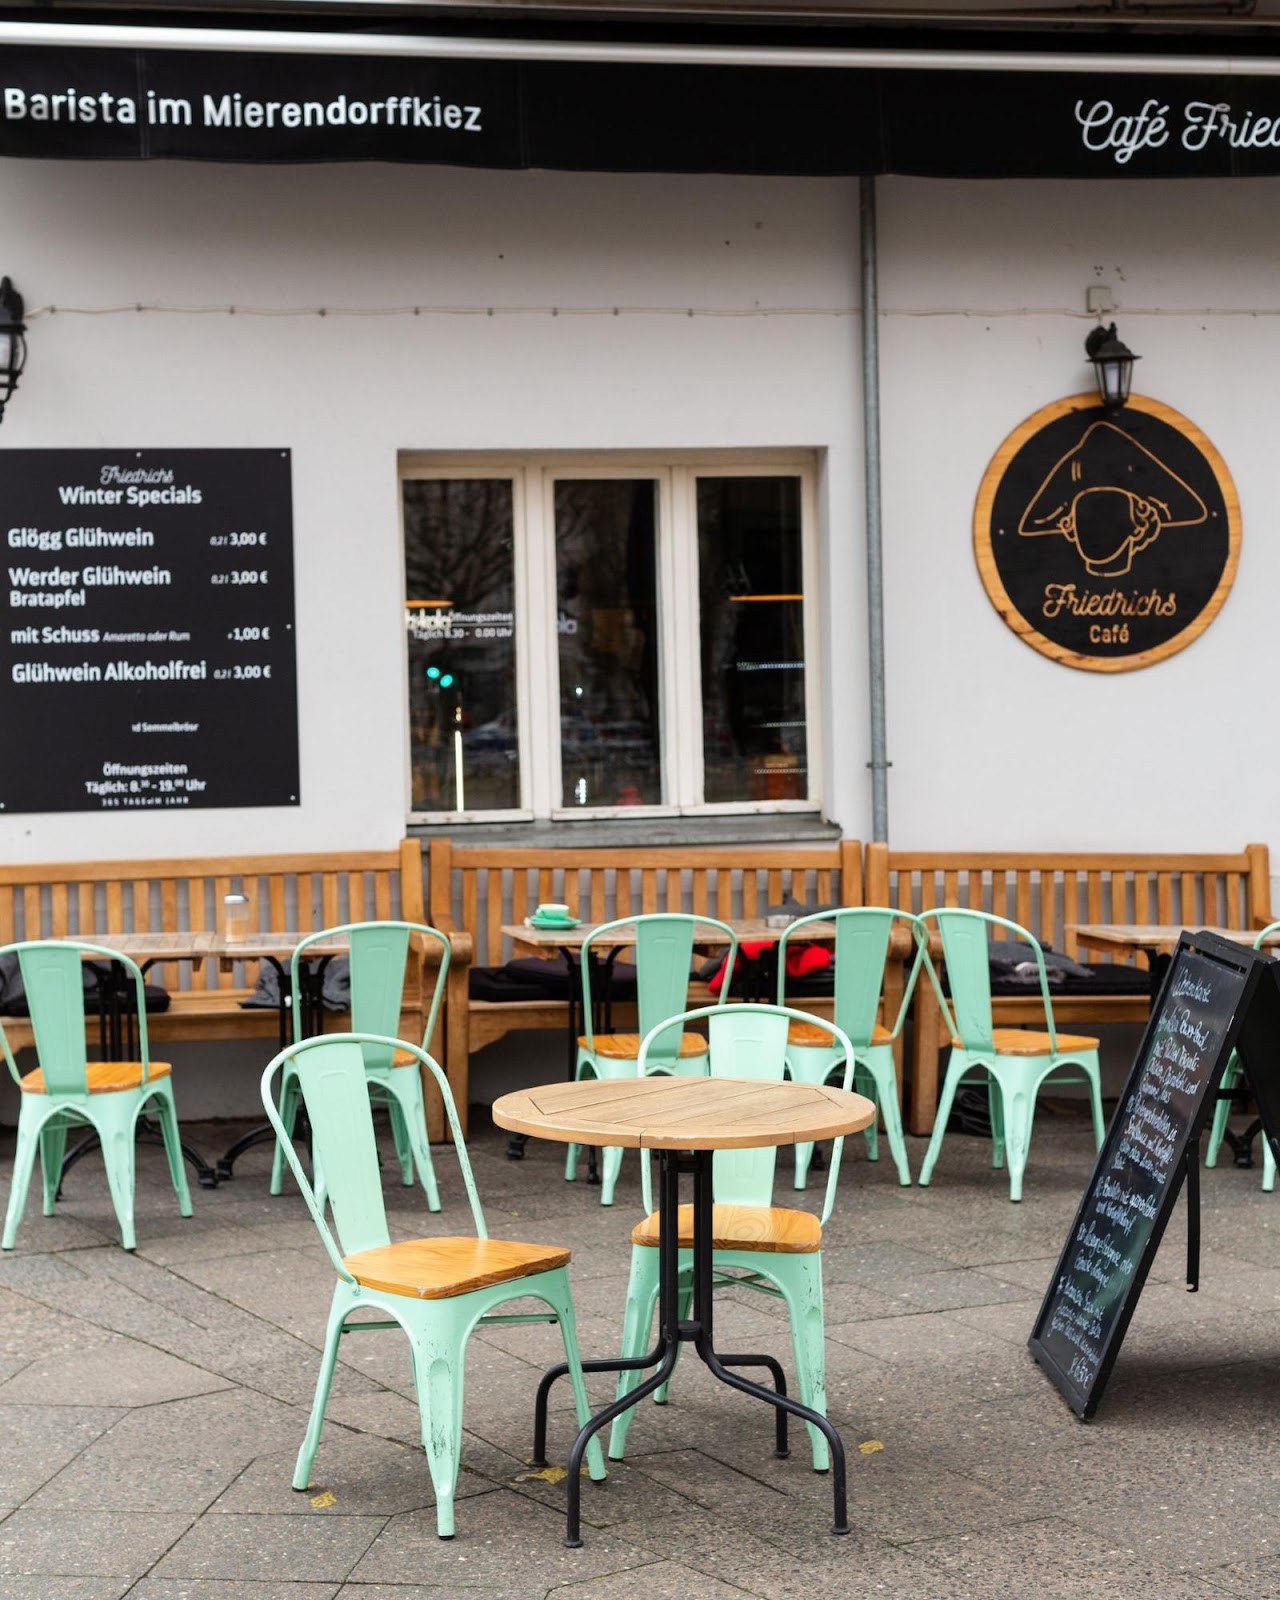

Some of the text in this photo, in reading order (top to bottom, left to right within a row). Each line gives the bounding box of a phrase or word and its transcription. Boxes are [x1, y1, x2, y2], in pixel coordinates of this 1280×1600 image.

[5, 88, 481, 130] Barista im Mierendorffkiez
[1075, 100, 1169, 163] Café
[100, 466, 173, 484] Friedrichs
[59, 485, 202, 507] Winter Specials
[8, 528, 62, 550] Glögg
[66, 527, 154, 547] Glühwein
[230, 532, 257, 546] 3,00
[259, 533, 266, 545] €
[9, 567, 79, 586] Werder
[83, 566, 170, 585] Glühwein
[232, 571, 258, 584] 3,00
[260, 571, 267, 583] €
[10, 589, 85, 608] Bratapfel
[1043, 584, 1176, 617] Friedrichs
[11, 627, 39, 643] mit
[42, 626, 100, 643] Schuss
[103, 632, 148, 642] Amaretto
[148, 631, 167, 641] oder
[169, 631, 190, 641] Rum
[262, 627, 269, 640] €
[1090, 623, 1129, 643] Café
[12, 663, 101, 682] Glühwein
[104, 660, 206, 680] Alkoholfrei
[234, 666, 261, 679] 3,00
[263, 665, 270, 678] €
[103, 763, 187, 777] Öffnungszeiten
[85, 781, 128, 795] Täglich:
[186, 779, 206, 791] Uhr
